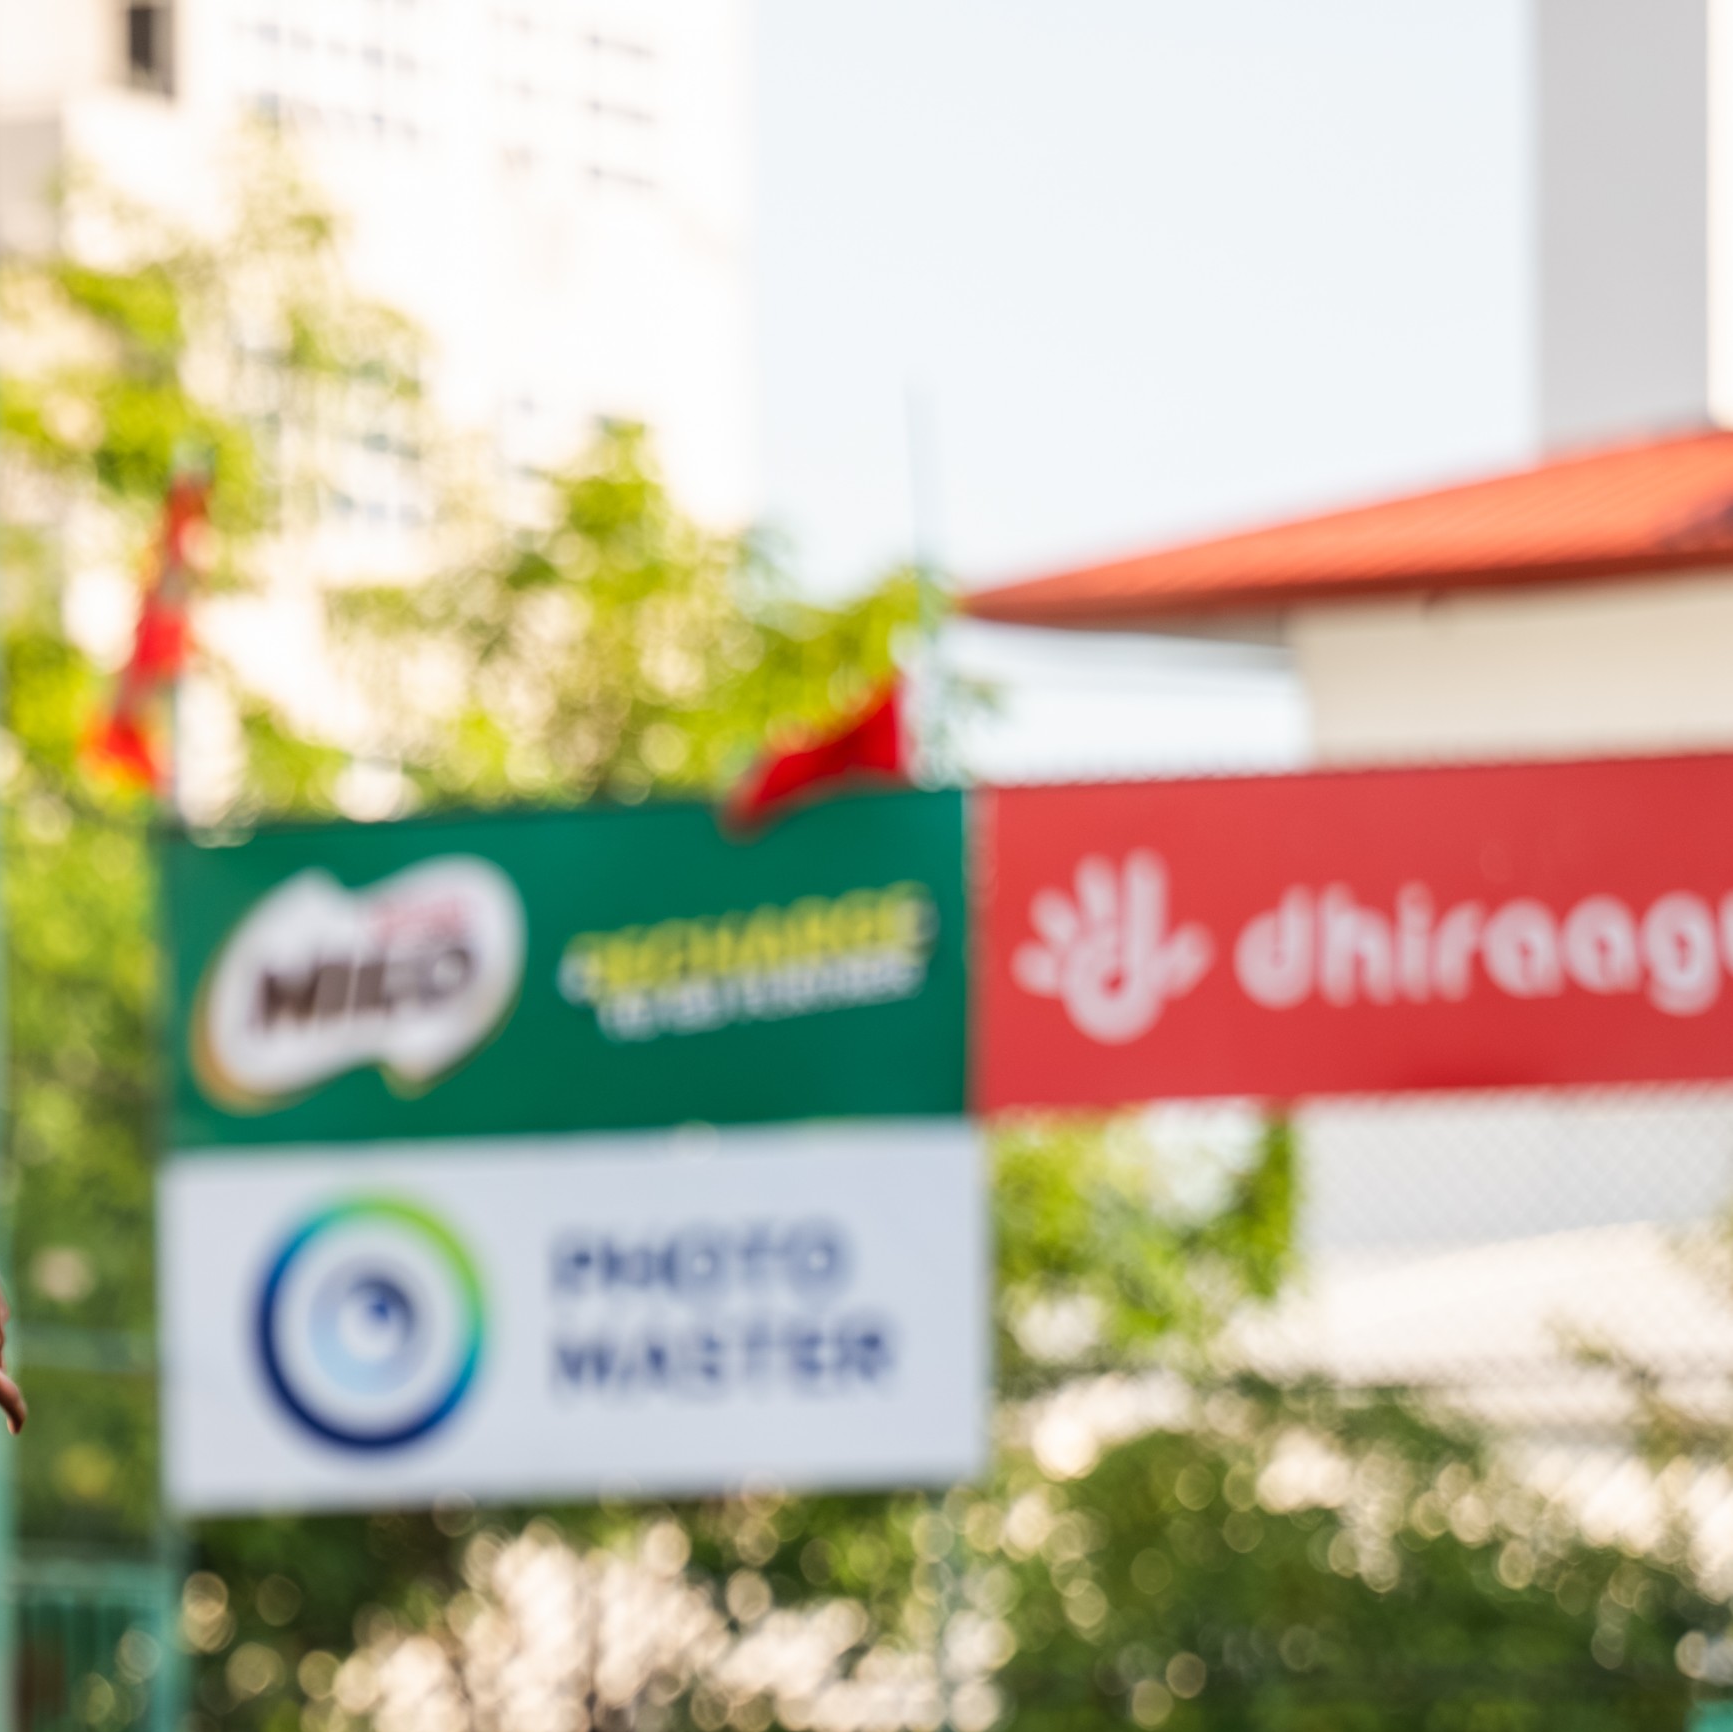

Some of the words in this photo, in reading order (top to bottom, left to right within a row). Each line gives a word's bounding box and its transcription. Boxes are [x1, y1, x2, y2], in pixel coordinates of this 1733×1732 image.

[1233, 878, 1733, 1018] dhiraag
[553, 1216, 847, 1296] PHOTO
[553, 1316, 895, 1398] MASTER
